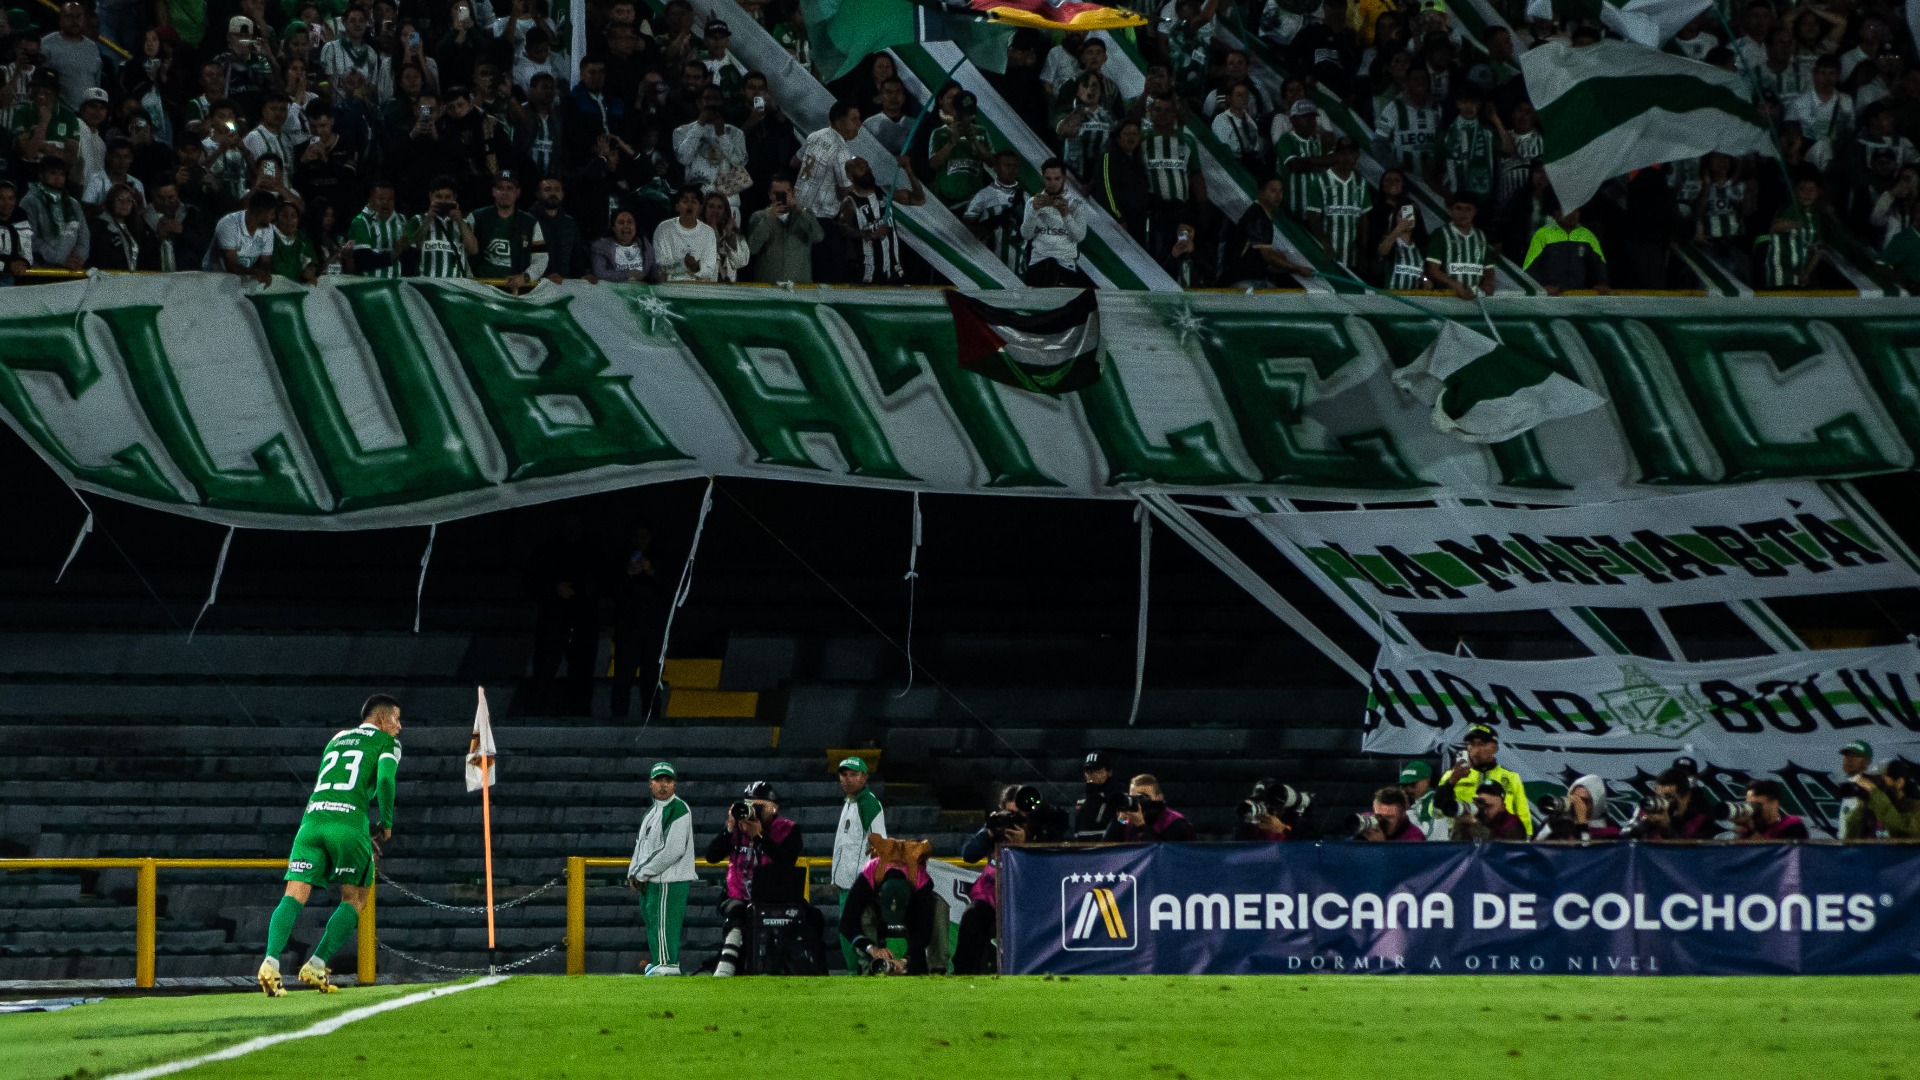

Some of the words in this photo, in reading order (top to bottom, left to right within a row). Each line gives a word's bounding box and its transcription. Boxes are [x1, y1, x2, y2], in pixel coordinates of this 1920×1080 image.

[0, 279, 697, 515] CLUB
[660, 298, 1920, 490] ATLETIC
[1321, 540, 1468, 600] LA
[1434, 528, 1728, 592] MAFIA
[1364, 668, 1612, 735] IUDAD
[1702, 668, 1920, 733] BOLIV
[314, 749, 364, 793] 23
[1150, 892, 1455, 930] AMERICANA
[1473, 893, 1537, 930] DE
[1288, 955, 1406, 970] DORMIR
[1429, 956, 1441, 969] A
[1465, 955, 1545, 970] OTRO
[1569, 955, 1660, 971] NIVEL
